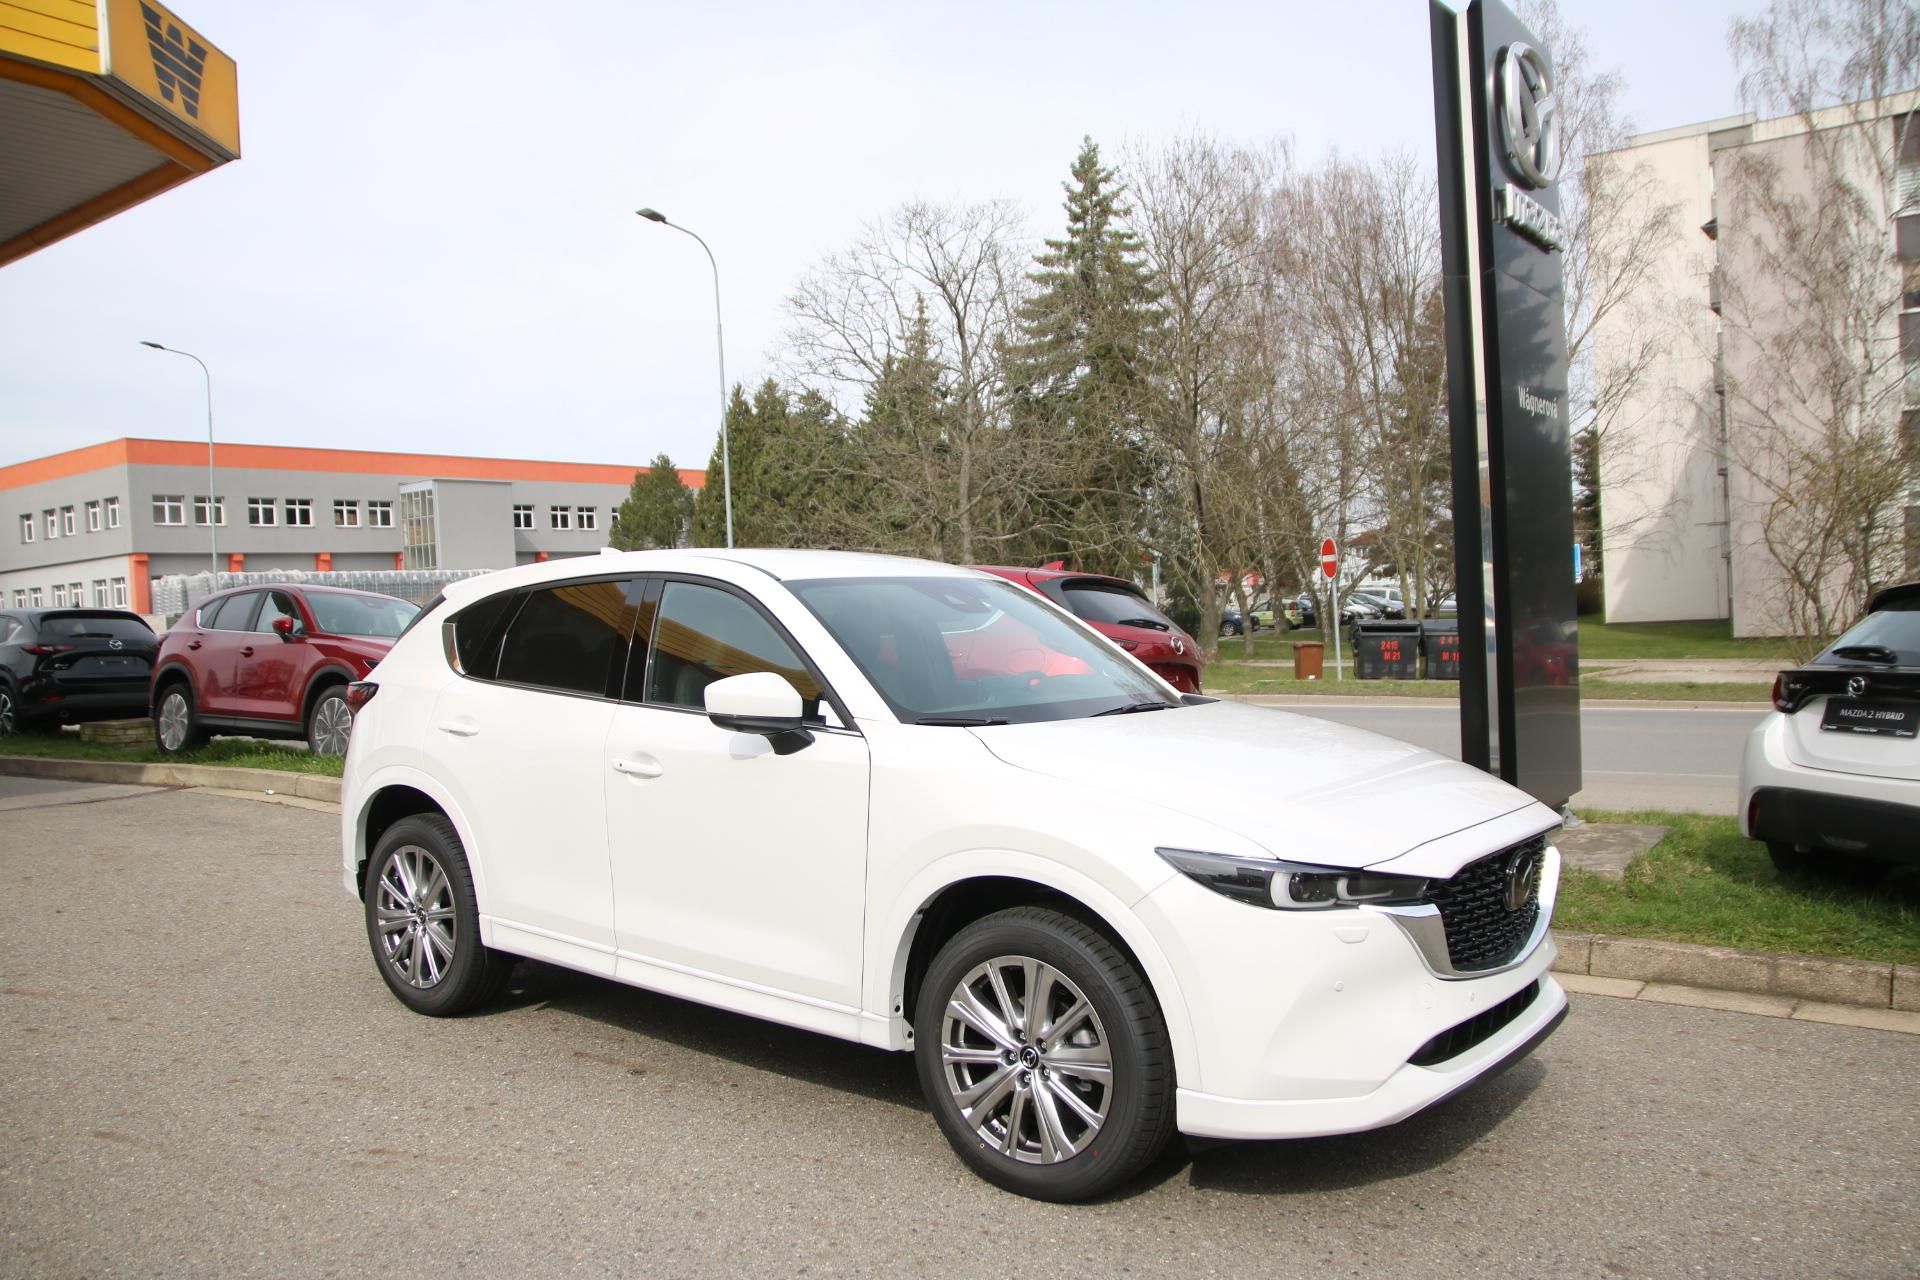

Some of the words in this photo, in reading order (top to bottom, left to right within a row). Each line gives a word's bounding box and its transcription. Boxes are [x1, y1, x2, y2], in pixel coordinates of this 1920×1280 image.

[1518, 385, 1558, 419] Wágnerová
[1840, 709, 1867, 718] MAZDA
[1875, 711, 1905, 720] HYBRID
